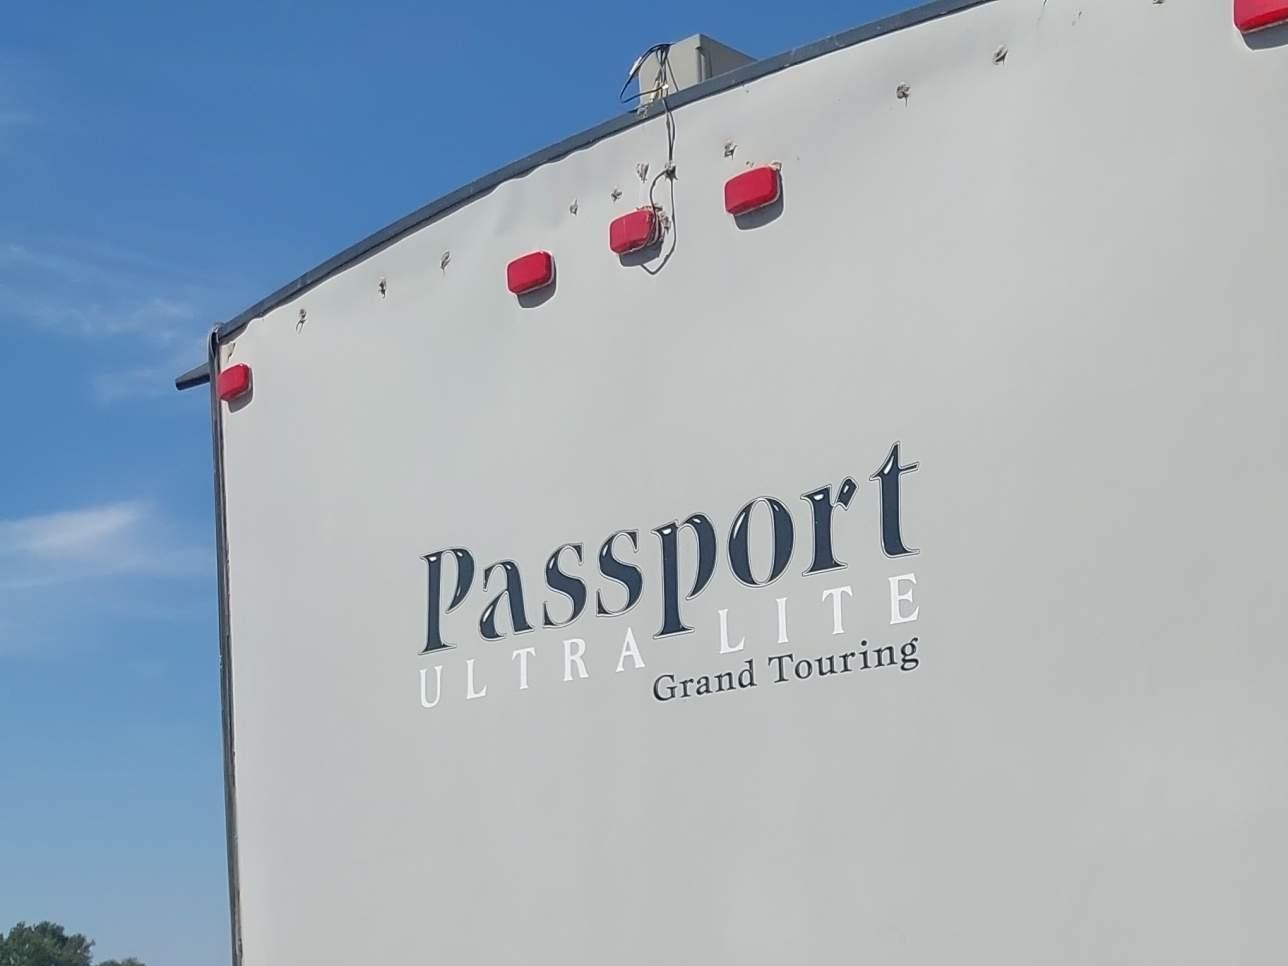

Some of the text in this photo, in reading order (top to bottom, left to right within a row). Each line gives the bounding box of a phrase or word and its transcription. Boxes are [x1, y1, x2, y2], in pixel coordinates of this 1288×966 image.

[417, 440, 920, 655] Passport
[418, 571, 921, 709] ULTRA LITE
[653, 636, 920, 702] Grand Touring
